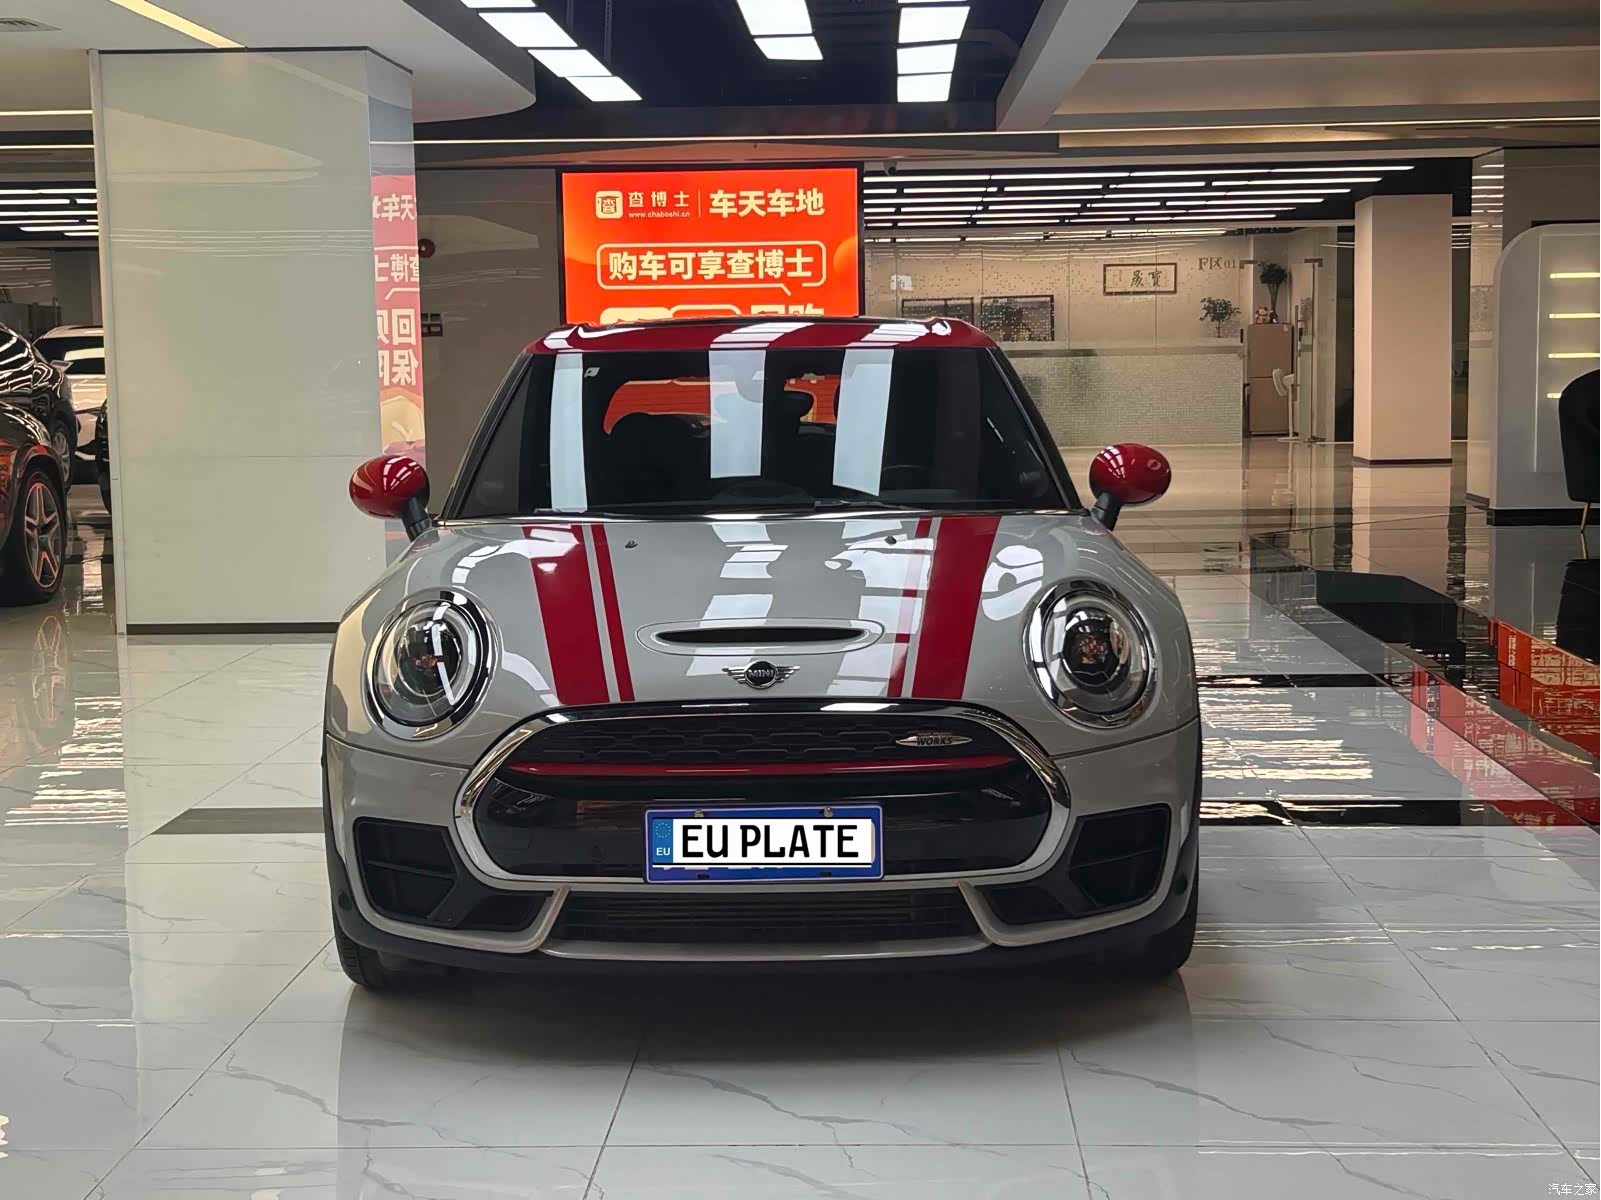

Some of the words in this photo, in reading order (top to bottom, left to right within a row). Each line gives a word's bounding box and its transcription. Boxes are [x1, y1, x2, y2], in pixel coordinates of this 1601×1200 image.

[628, 190, 690, 208] 查博士
[709, 187, 826, 218] 车天车地
[628, 210, 691, 219] www.chaboshi.cn
[608, 249, 814, 281] 购车可享查博士
[748, 669, 774, 678] MINI
[916, 736, 952, 746] WORKS
